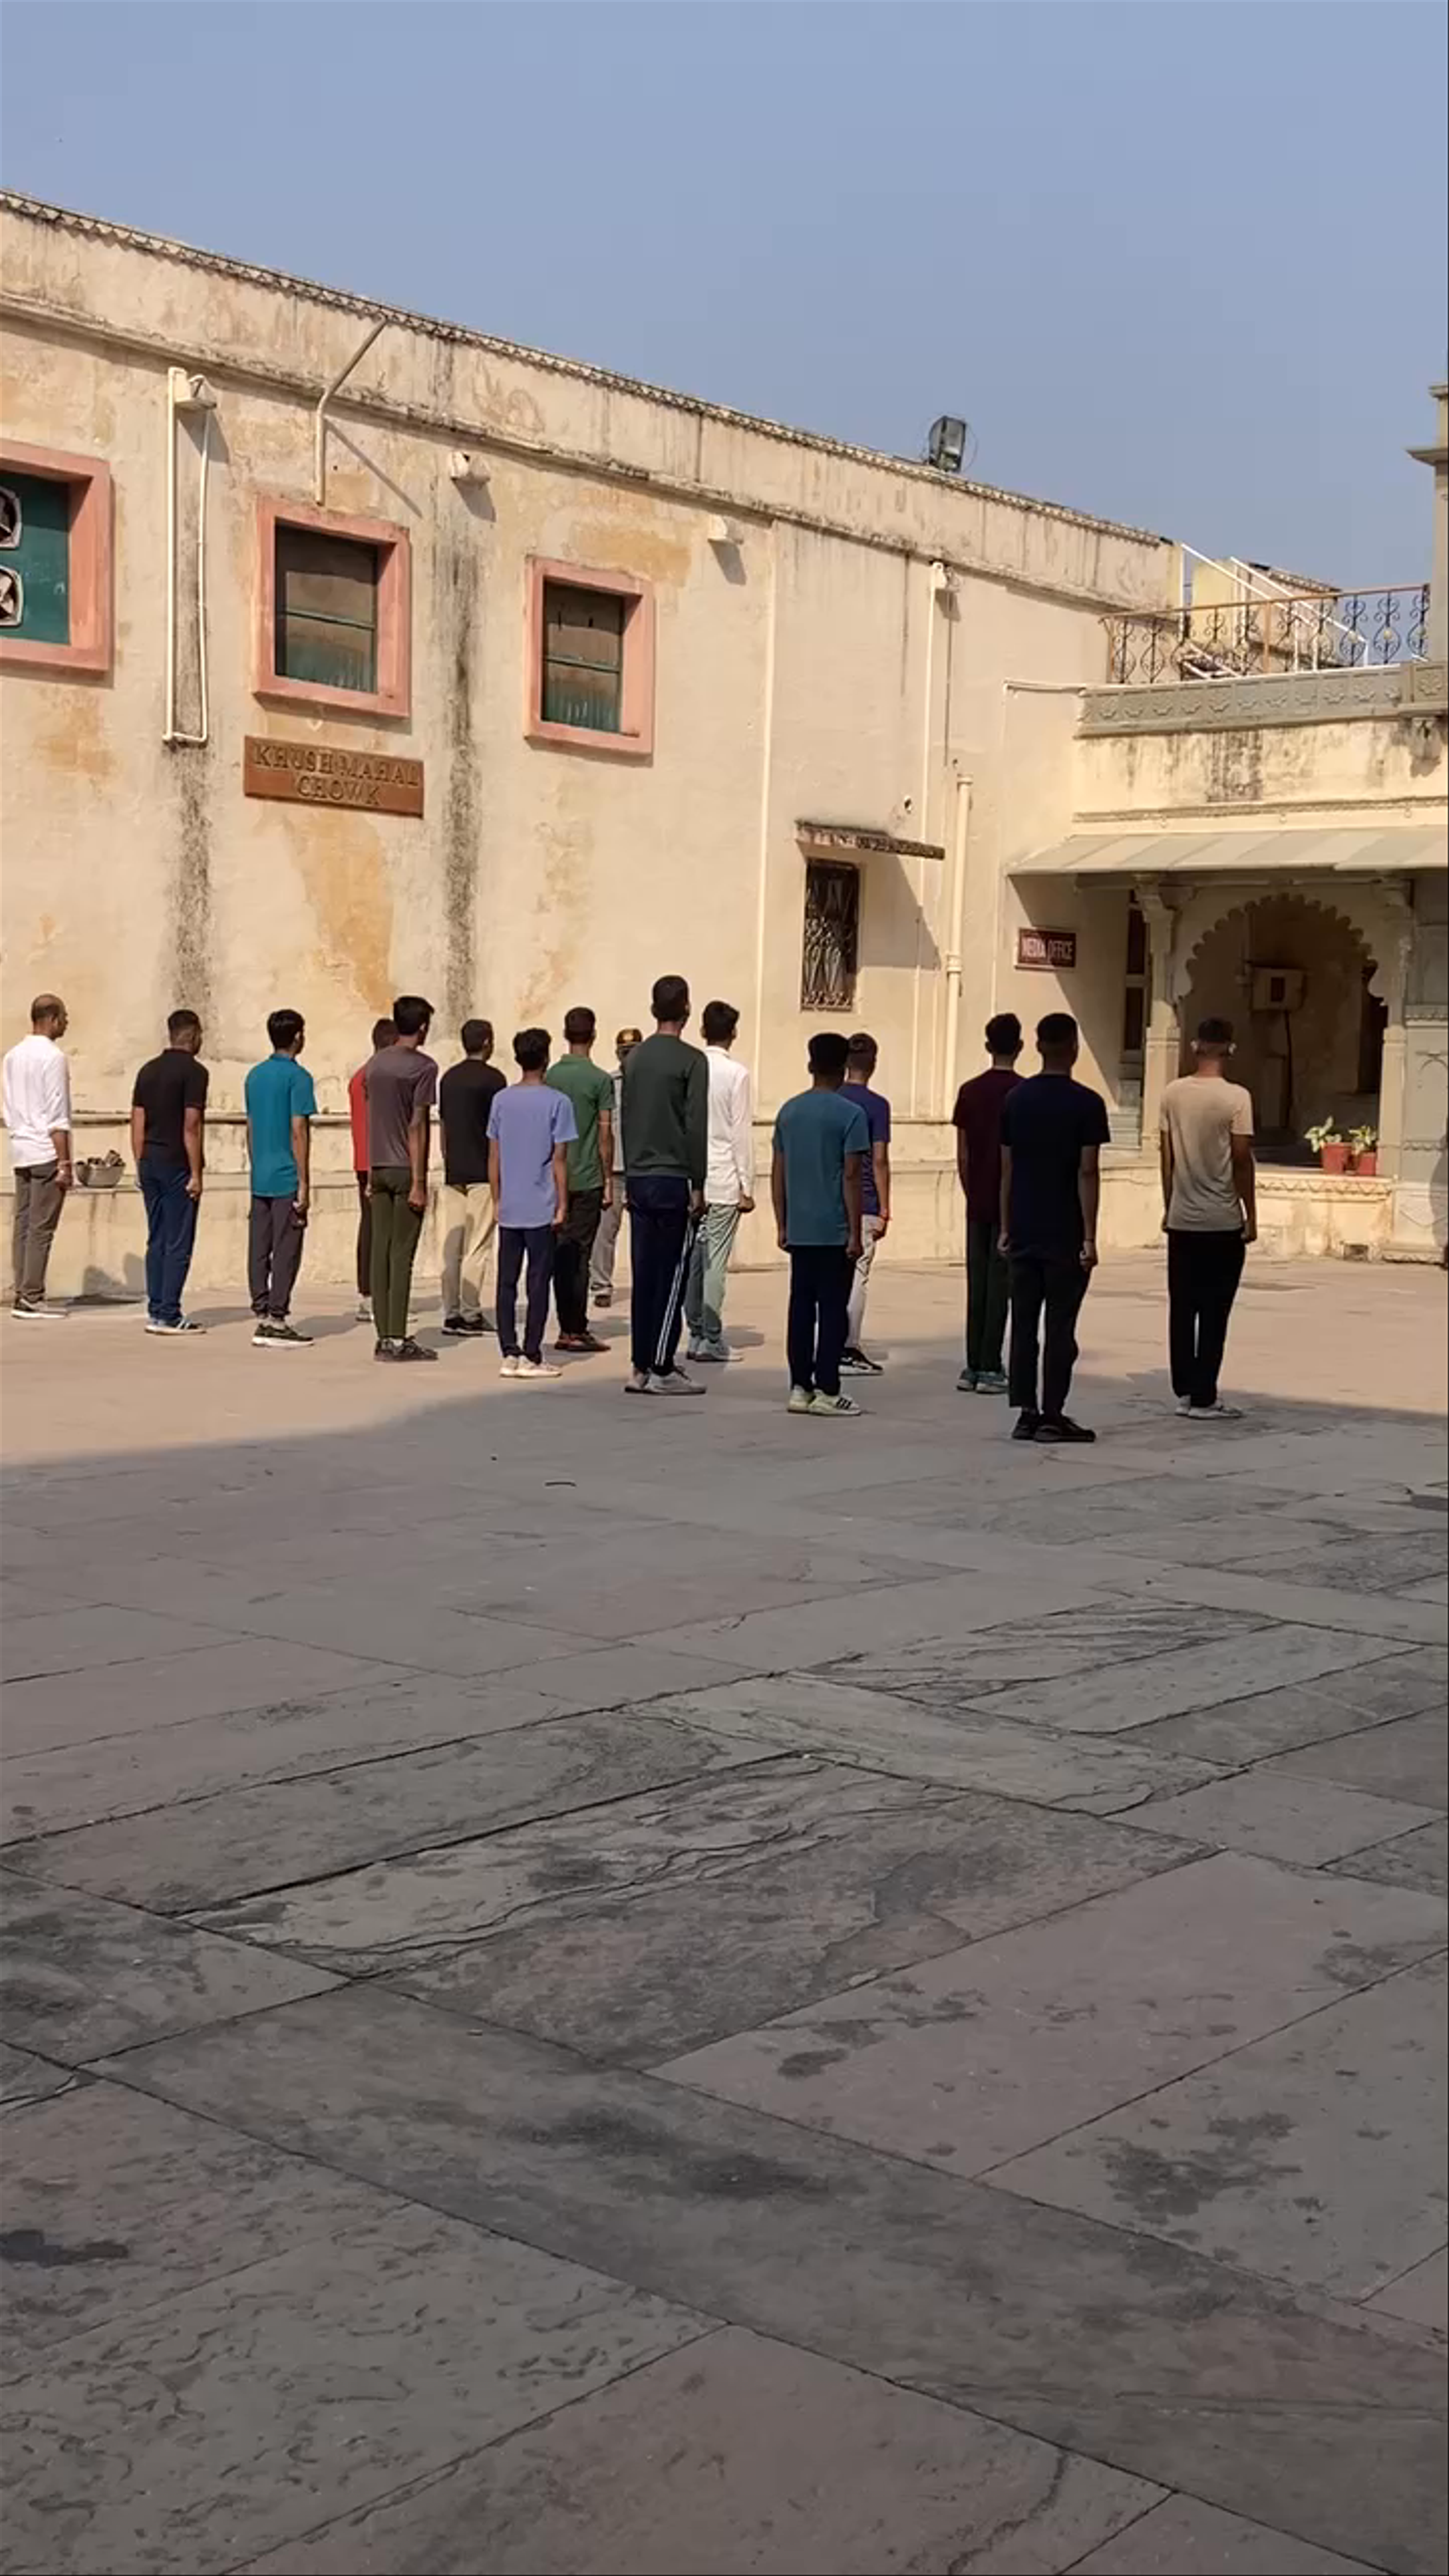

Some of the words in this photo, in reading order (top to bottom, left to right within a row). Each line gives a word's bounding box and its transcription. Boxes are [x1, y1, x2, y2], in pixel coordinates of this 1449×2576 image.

[255, 744, 333, 774] KHUSH
[338, 755, 418, 786] MAHAL
[298, 776, 380, 805] CHOWK
[1048, 940, 1073, 960] OFFICE
